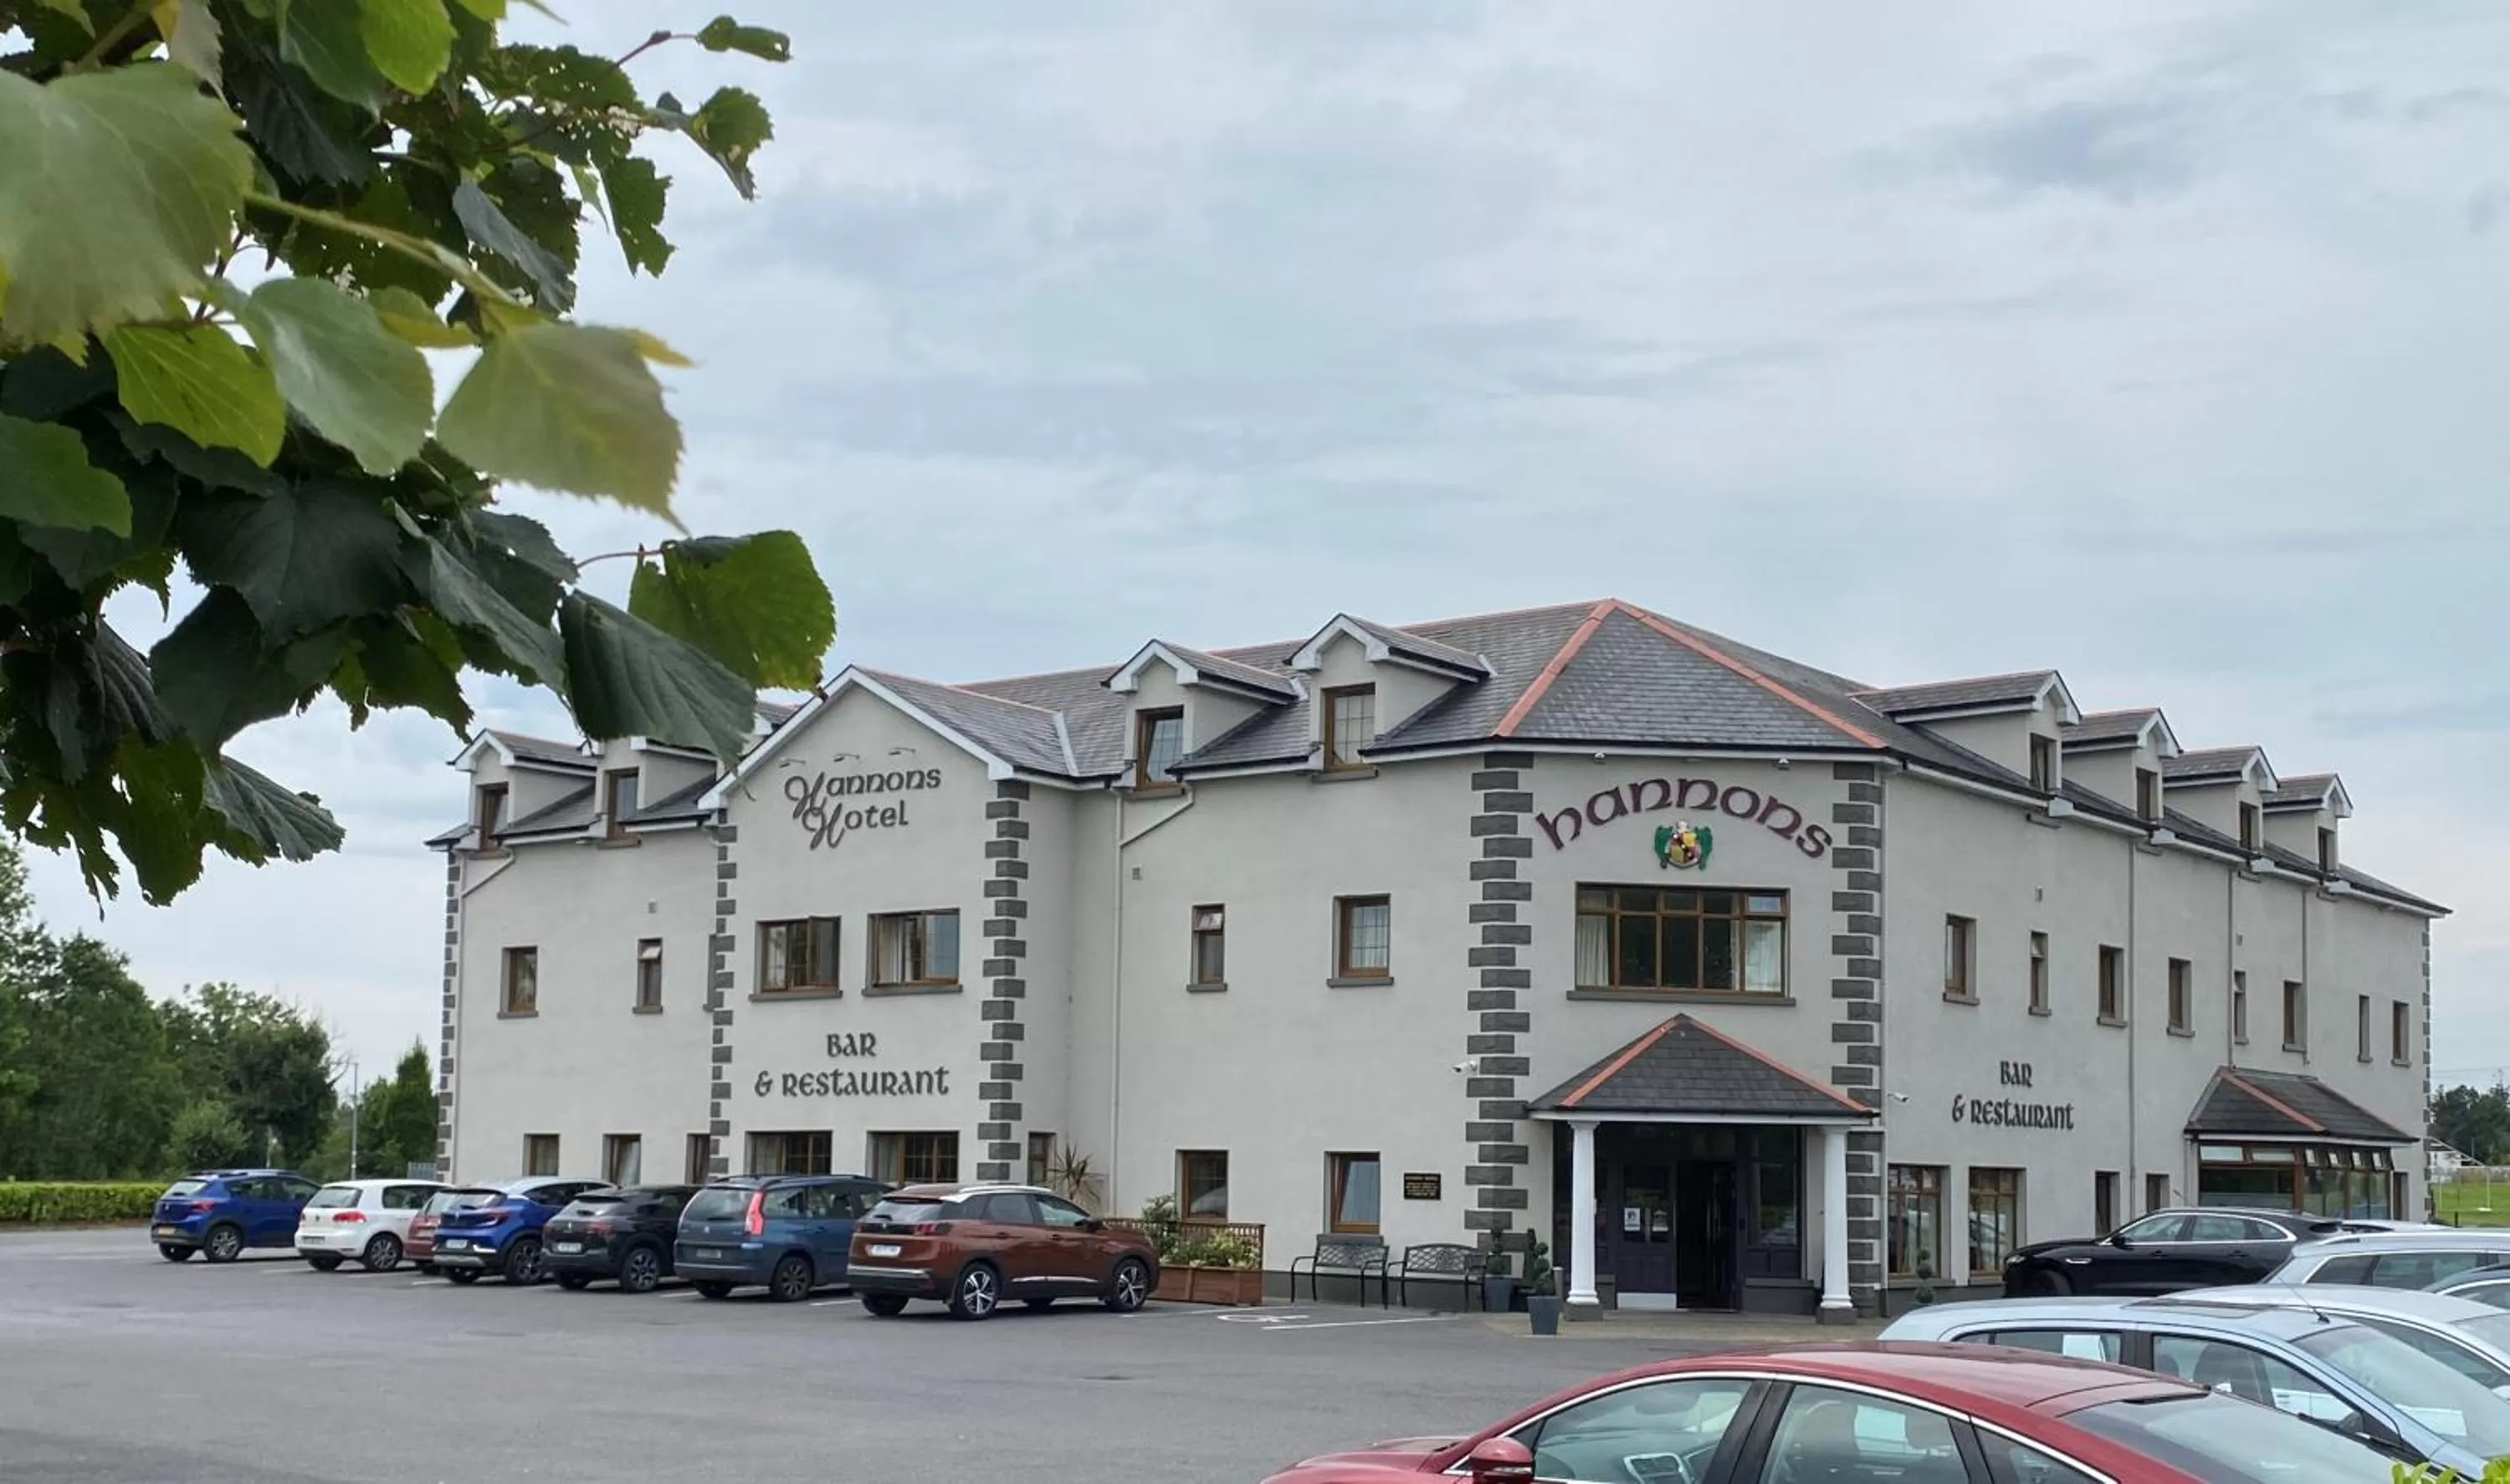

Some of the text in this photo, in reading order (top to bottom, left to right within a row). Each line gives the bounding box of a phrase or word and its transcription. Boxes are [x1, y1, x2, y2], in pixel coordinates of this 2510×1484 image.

[784, 769, 942, 820] Hannons
[802, 799, 909, 851] Hotel
[754, 1070, 773, 1097] &
[1952, 1093, 1965, 1123] &
